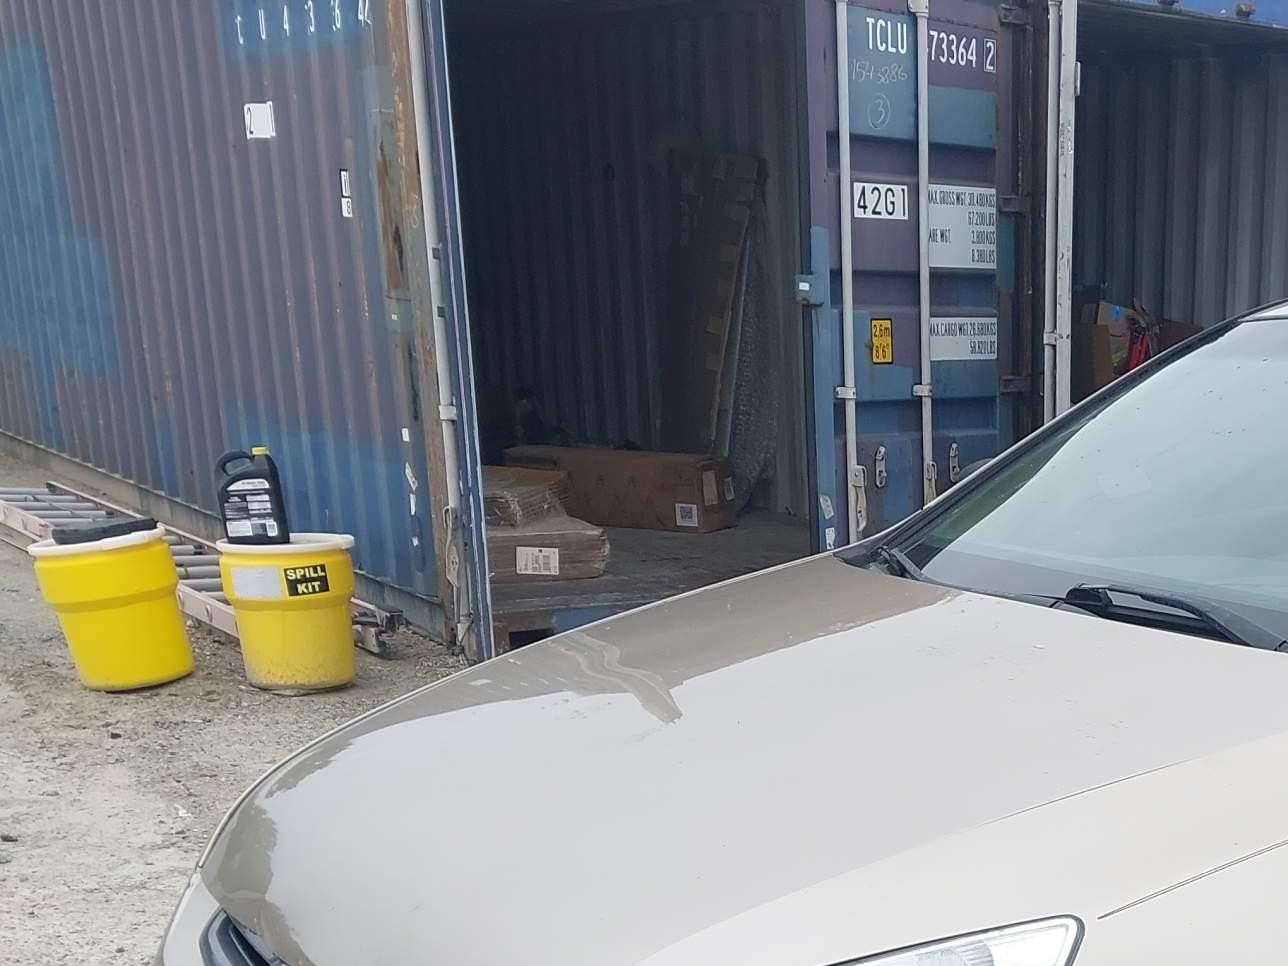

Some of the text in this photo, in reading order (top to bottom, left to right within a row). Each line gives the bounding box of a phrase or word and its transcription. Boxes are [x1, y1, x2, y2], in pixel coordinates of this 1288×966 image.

[866, 17, 995, 70] TCLU 73364 2
[857, 184, 906, 217] 42G1
[928, 228, 939, 244] ARE
[287, 566, 325, 580] SPILL
[297, 582, 320, 594] KIT
